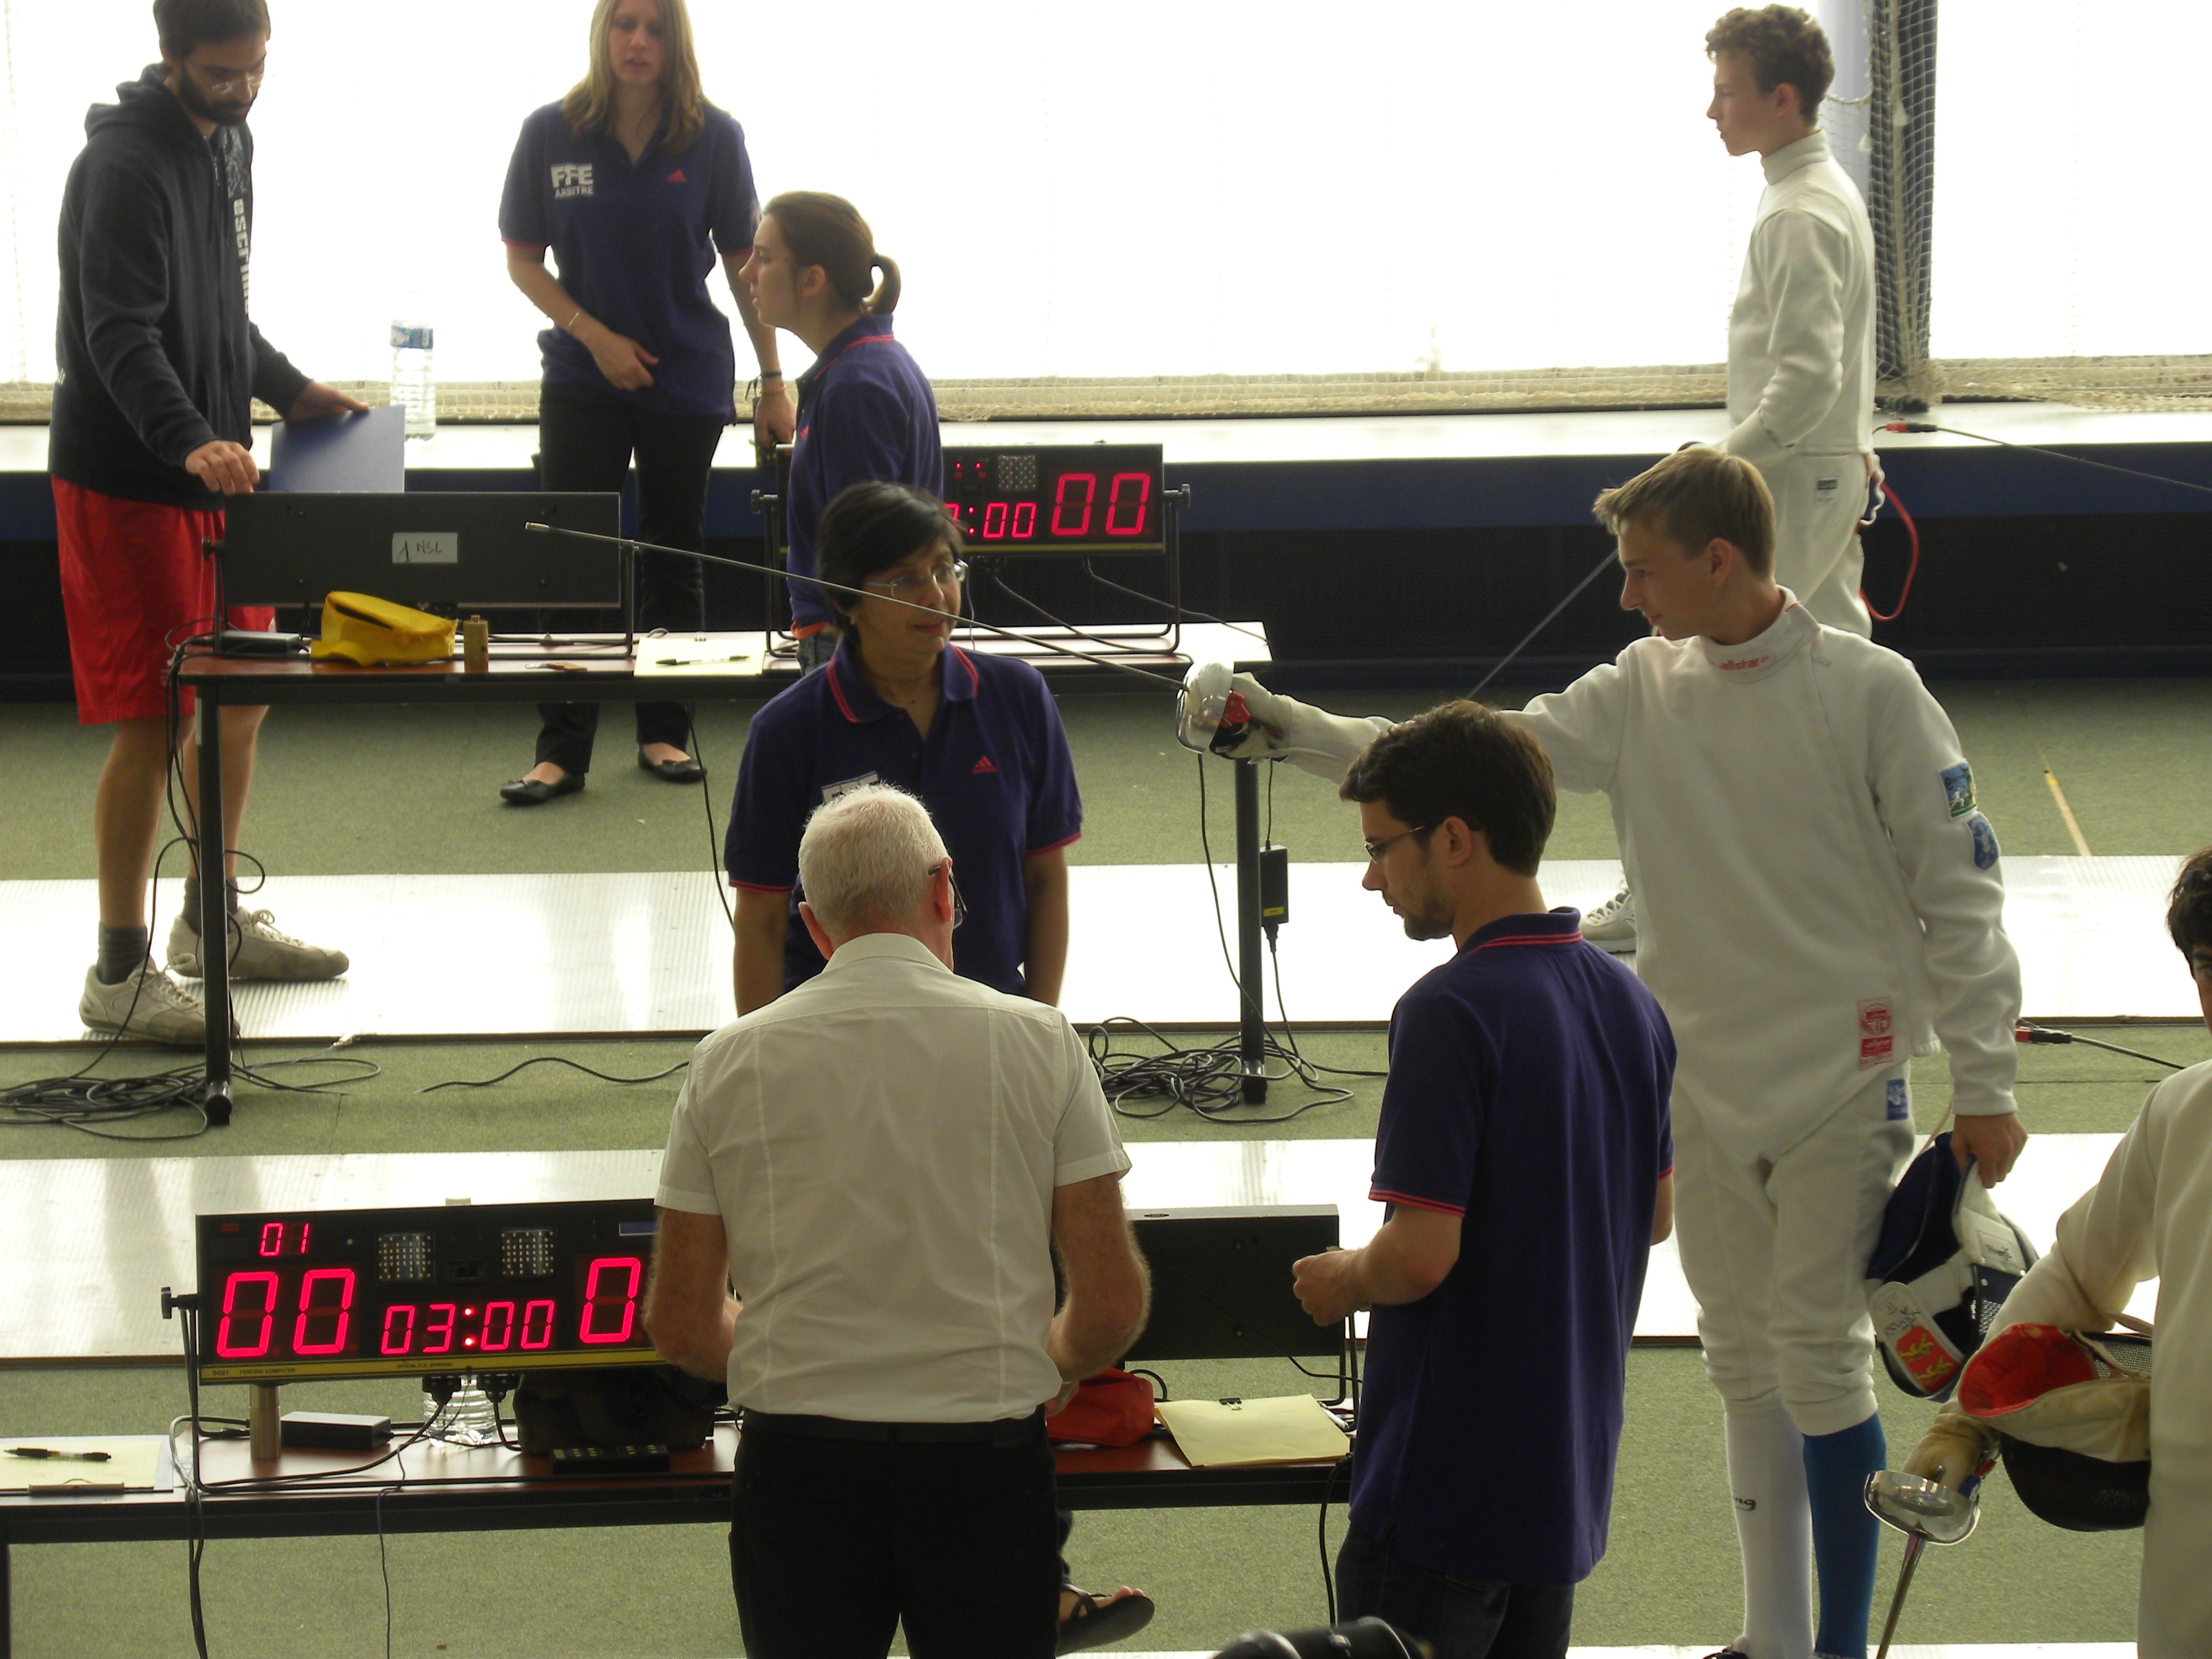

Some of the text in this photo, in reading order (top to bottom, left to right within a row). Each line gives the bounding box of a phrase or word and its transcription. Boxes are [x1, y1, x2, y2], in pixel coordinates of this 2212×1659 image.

[551, 164, 593, 187] FFE
[555, 185, 593, 199] ARBITRE
[1051, 473, 1151, 535] 00
[260, 1223, 310, 1256] 01
[216, 1257, 641, 1357] 00 03:00 0
